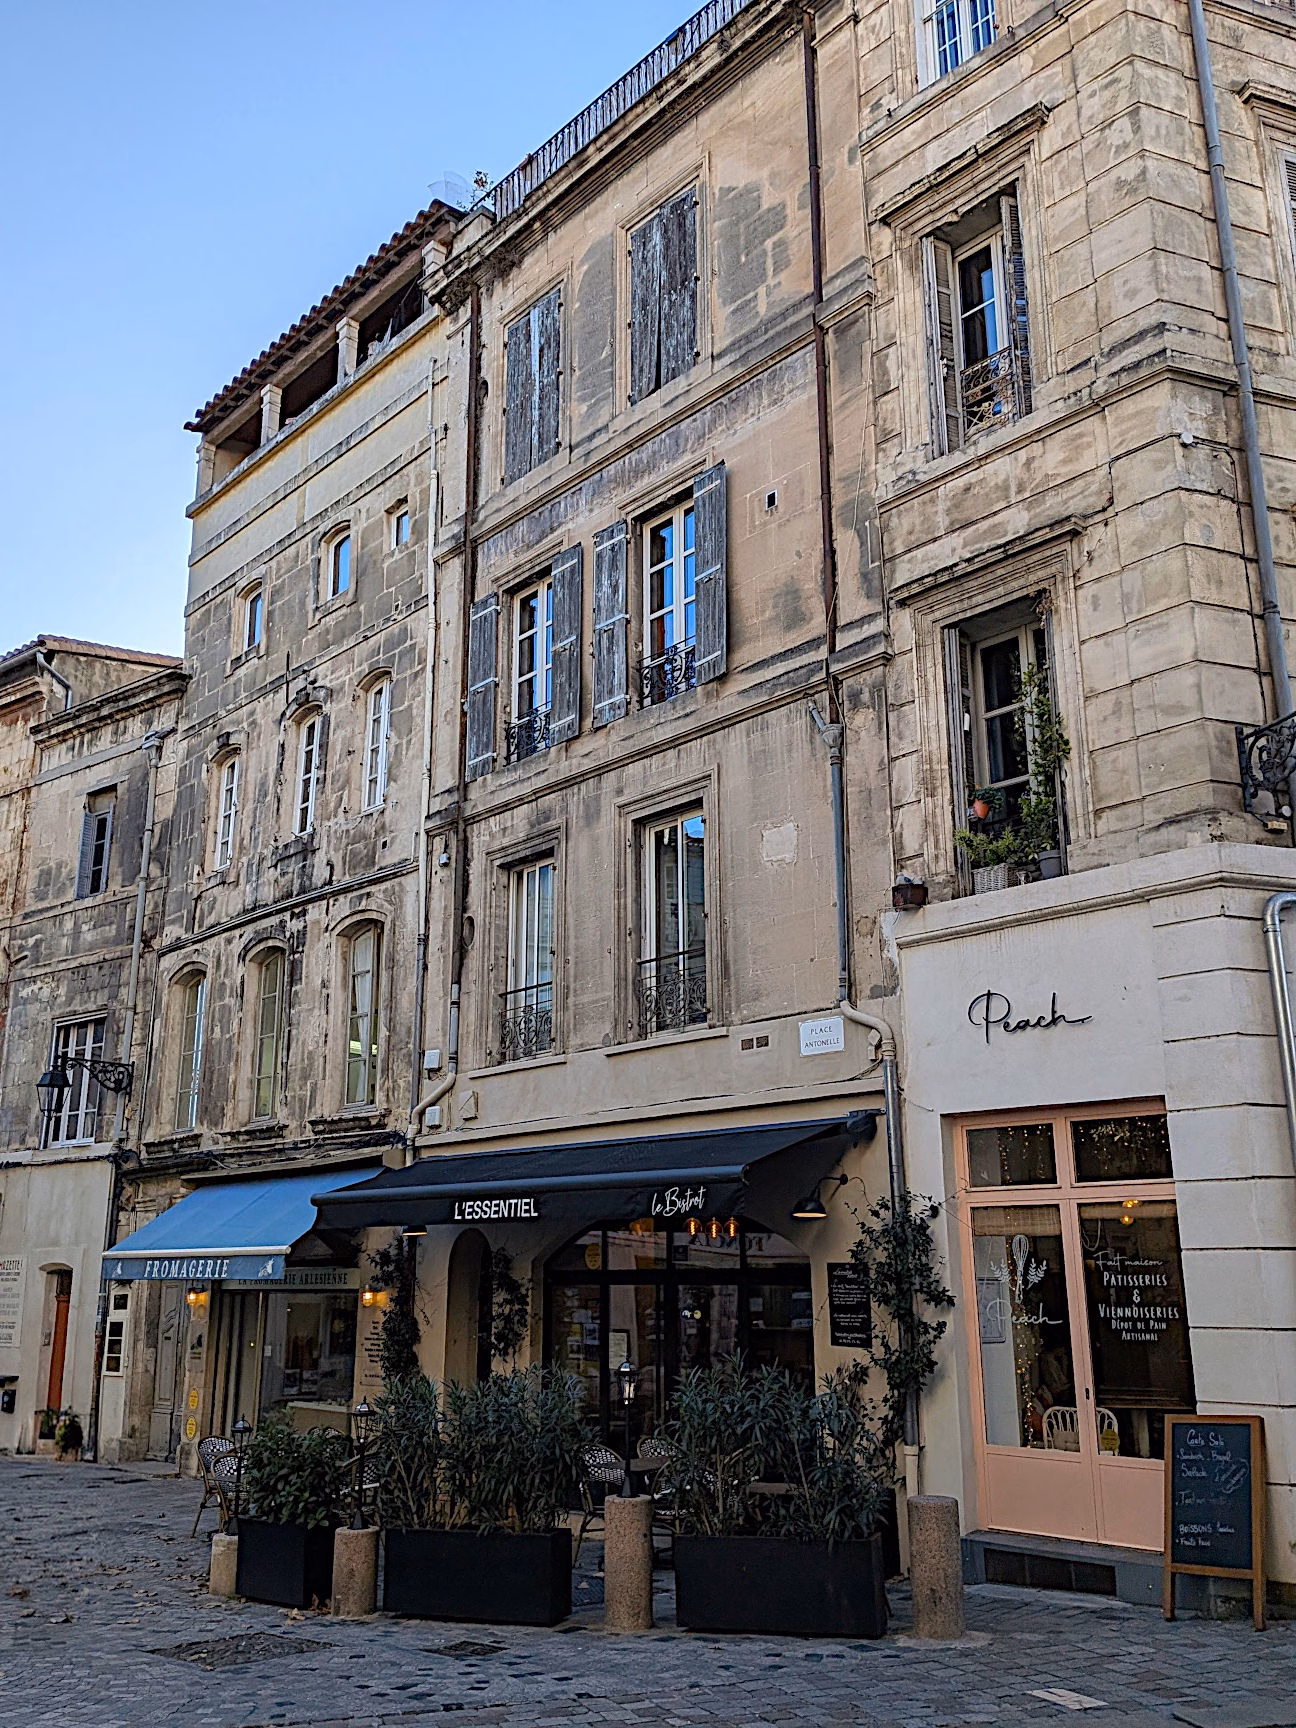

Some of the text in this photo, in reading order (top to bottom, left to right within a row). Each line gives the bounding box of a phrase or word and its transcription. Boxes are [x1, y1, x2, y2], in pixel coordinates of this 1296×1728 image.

[967, 989, 1093, 1044] Peach
[810, 1026, 832, 1035] PLACE
[804, 1037, 840, 1049] ANTONELLE
[453, 1198, 539, 1220] L'ESSENTIEL
[663, 1185, 707, 1217] Bistrot
[143, 1259, 230, 1279] FROMAGERIE
[1093, 1250, 1163, 1272] Fait maison
[299, 1273, 348, 1285] ARLESIENNE
[1103, 1271, 1168, 1287] PATISSERIES
[1132, 1288, 1141, 1304] &
[986, 1297, 1064, 1336] Peach
[1098, 1303, 1180, 1319] VIENNOISERIES
[1137, 1321, 1146, 1330] DE
[1149, 1319, 1167, 1330] PAIN
[1121, 1330, 1159, 1341] ARTISANAL
